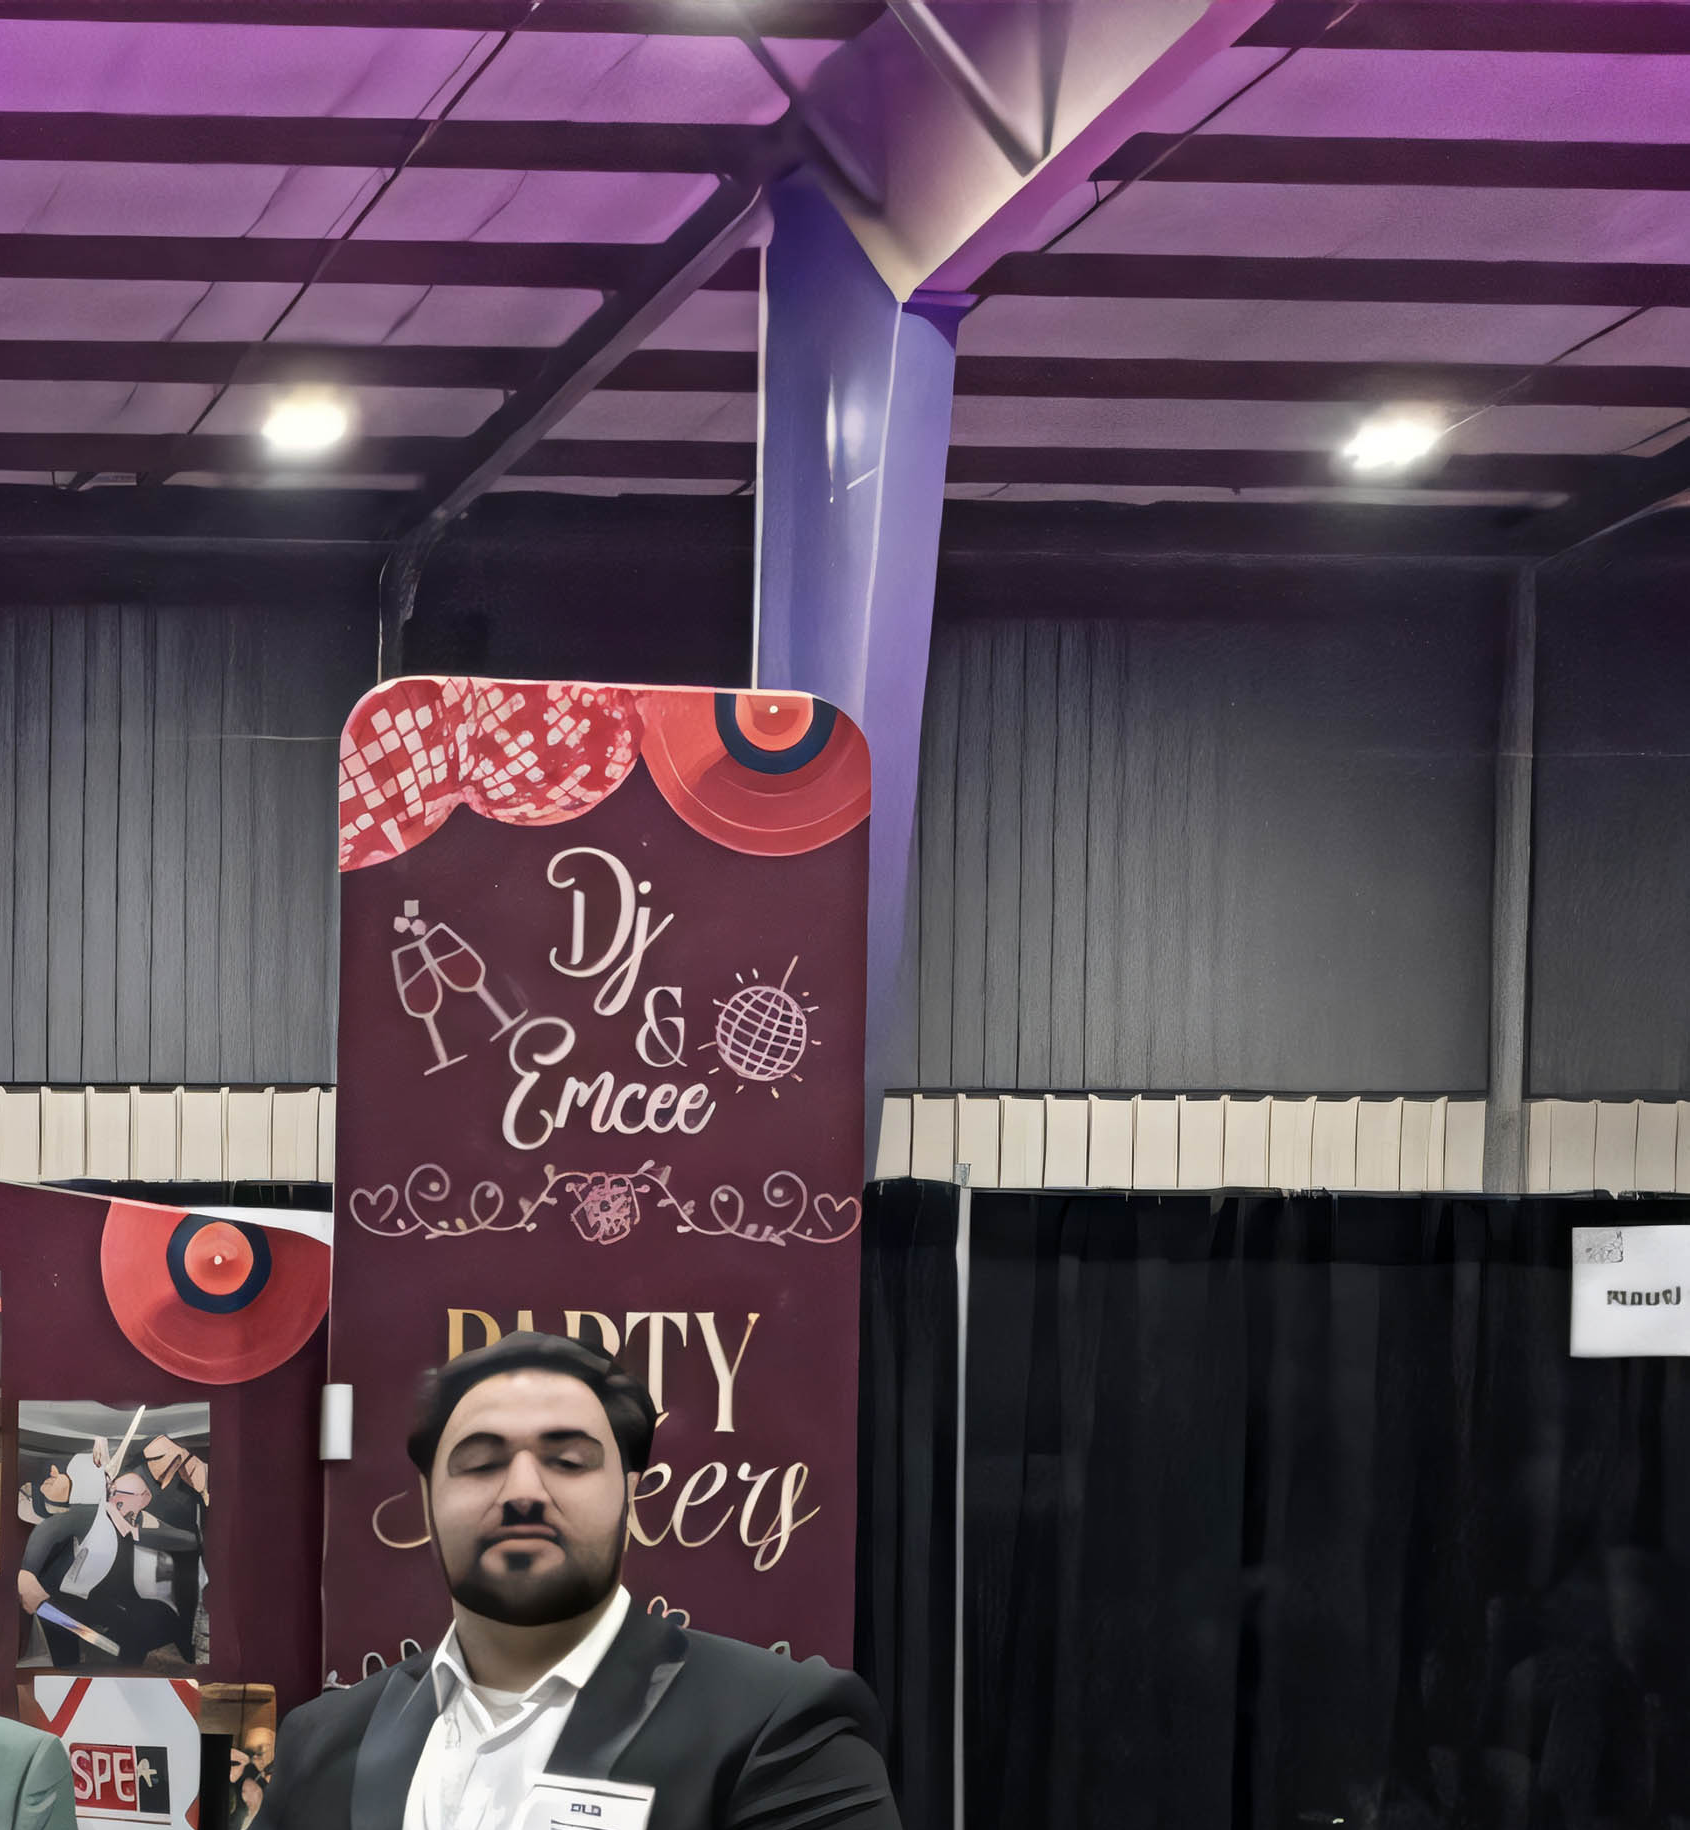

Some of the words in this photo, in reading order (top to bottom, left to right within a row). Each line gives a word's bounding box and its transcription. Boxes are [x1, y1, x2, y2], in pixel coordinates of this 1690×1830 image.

[547, 847, 675, 1017] Dj
[502, 1016, 716, 1150] Emcee
[635, 986, 688, 1068] &
